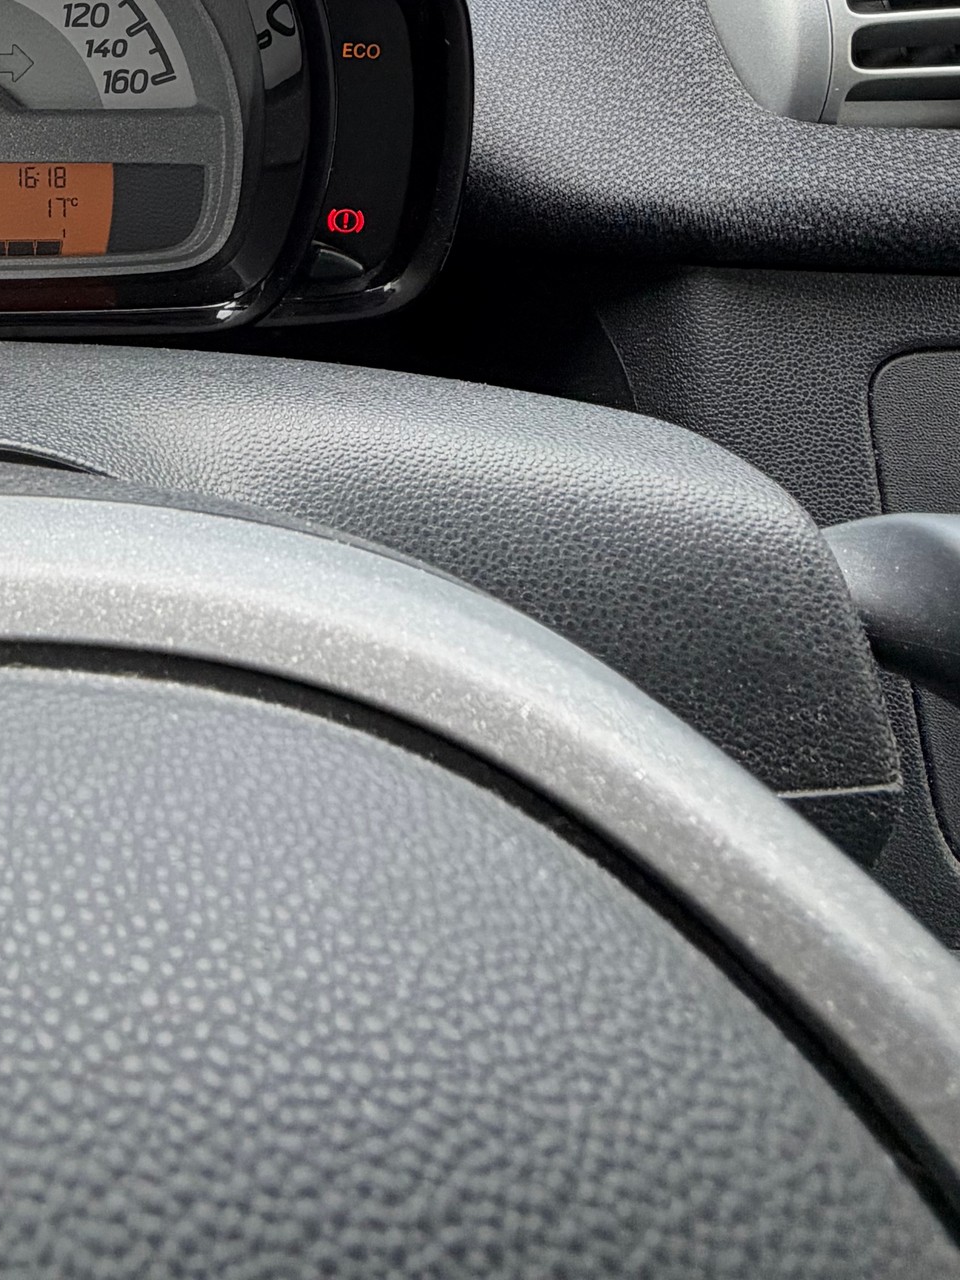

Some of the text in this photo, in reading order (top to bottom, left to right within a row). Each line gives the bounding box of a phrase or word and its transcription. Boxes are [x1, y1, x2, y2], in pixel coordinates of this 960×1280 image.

[63, 2, 110, 28] 120
[85, 39, 128, 58] 140
[342, 42, 381, 59] ECO
[103, 68, 149, 94] 160
[19, 166, 66, 189] 16:18
[62, 228, 66, 239] 1
